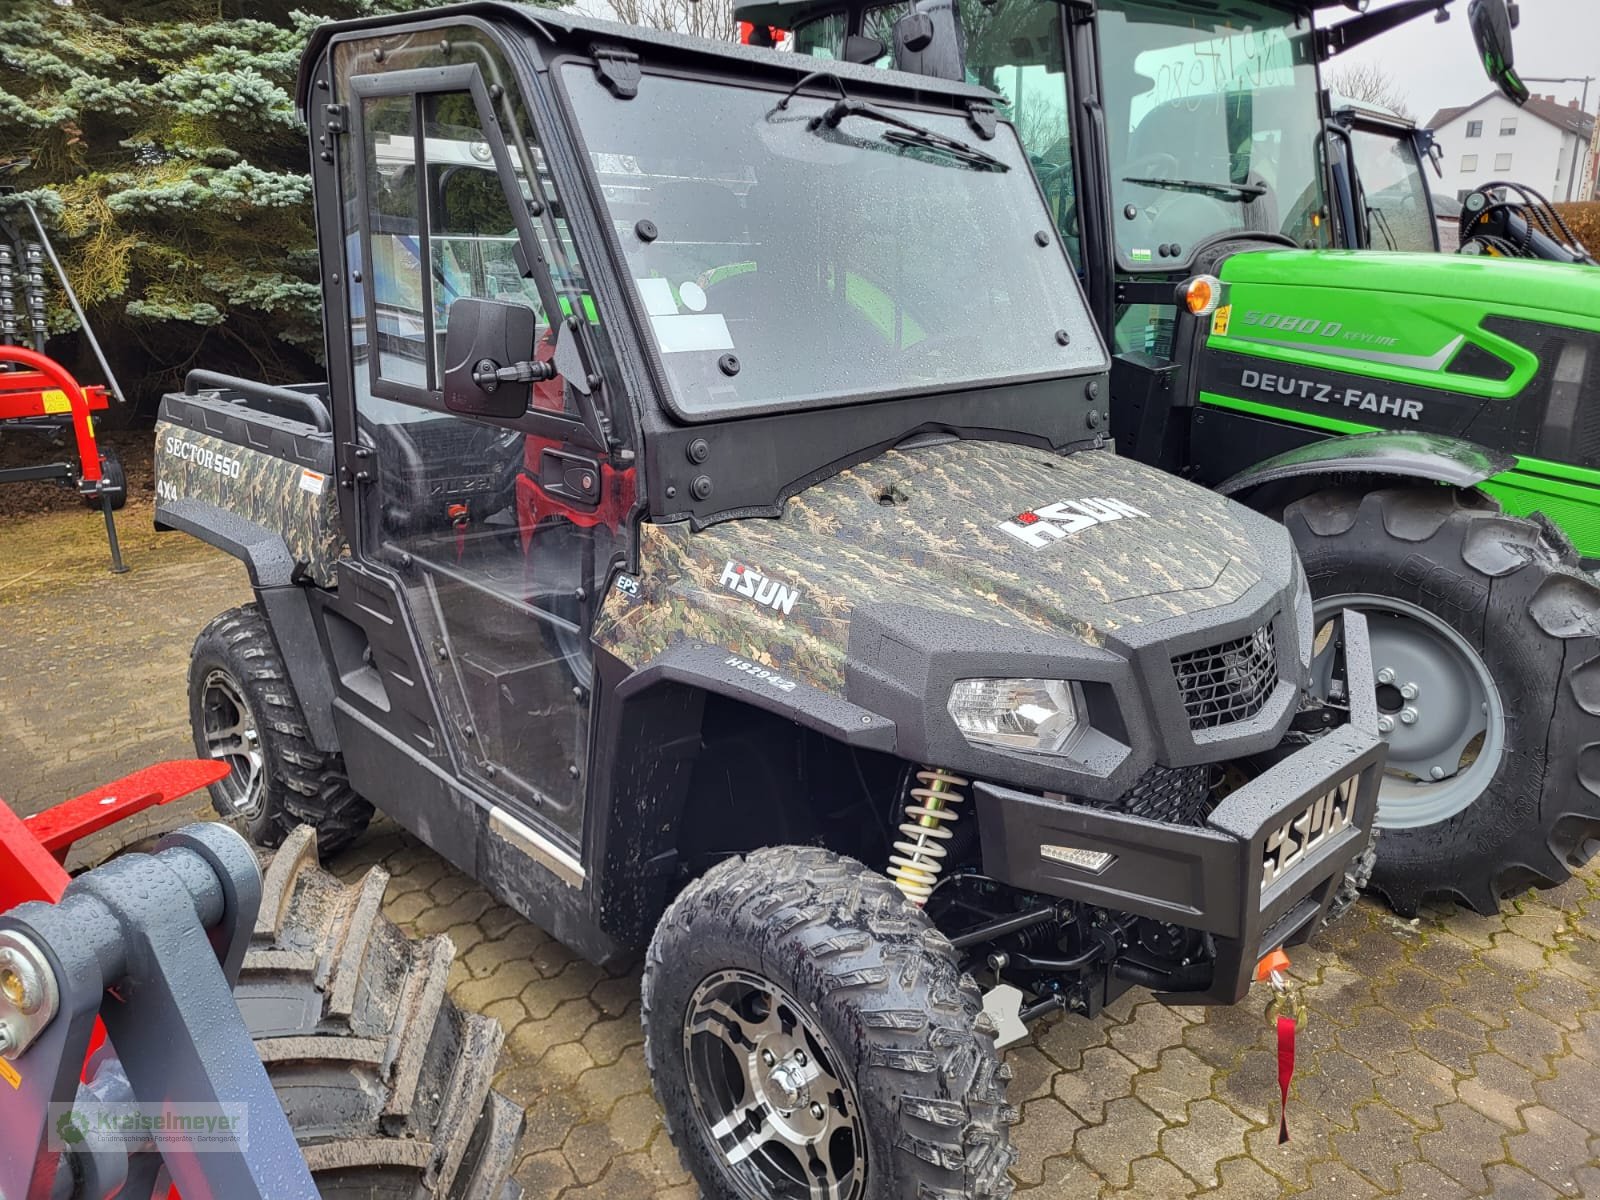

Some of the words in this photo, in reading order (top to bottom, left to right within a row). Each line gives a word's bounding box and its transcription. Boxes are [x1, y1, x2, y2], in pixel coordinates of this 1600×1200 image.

[1243, 310, 1321, 334] 5080
[1241, 370, 1424, 421] DEUTZ-FAHR
[998, 497, 1152, 549] HSUN
[616, 575, 639, 595] EPS
[719, 560, 799, 615] HSUN
